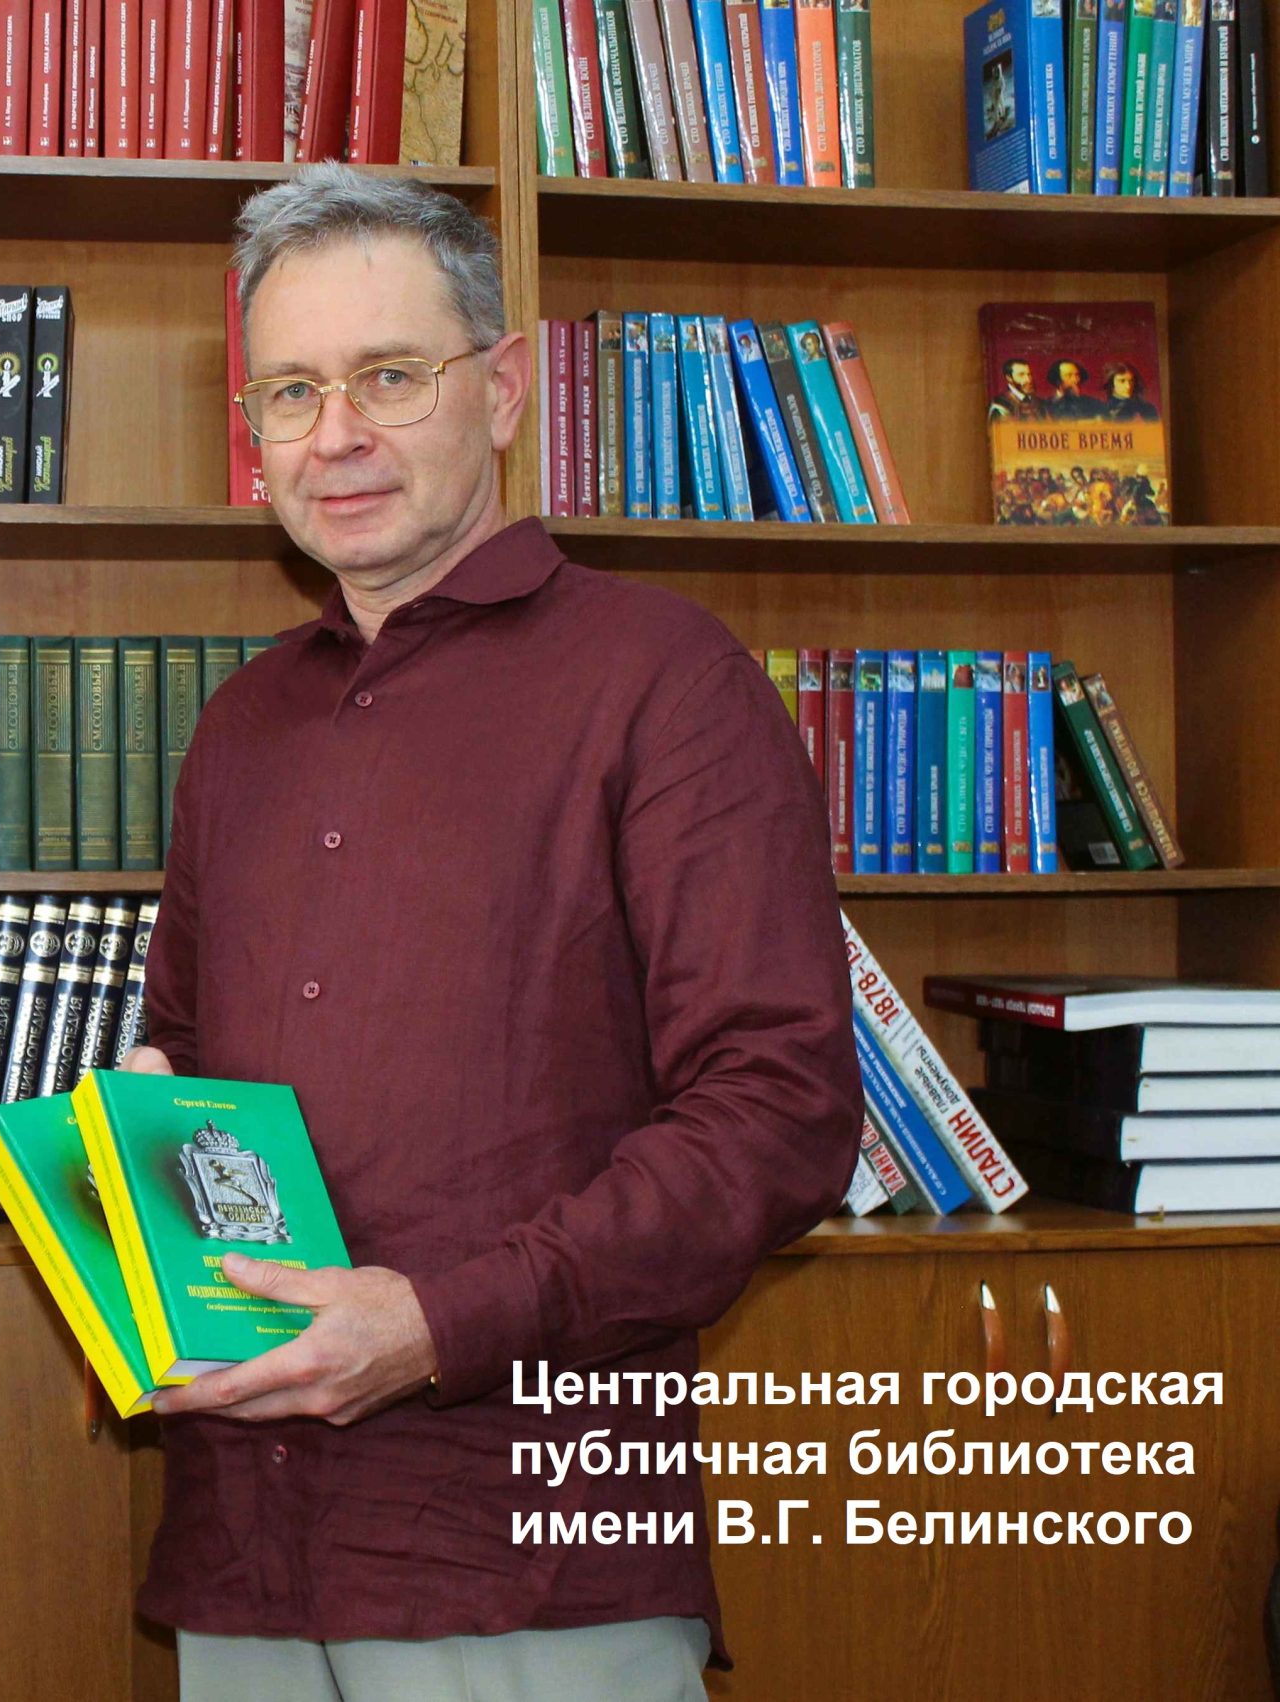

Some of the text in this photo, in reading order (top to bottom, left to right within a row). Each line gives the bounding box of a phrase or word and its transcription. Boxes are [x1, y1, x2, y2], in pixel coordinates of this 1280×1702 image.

[581, 82, 592, 119] ВЕЛИКИХ
[615, 87, 626, 124] ВЕЛИКИХ
[855, 98, 864, 134] ВЕЛИКИХ
[585, 123, 594, 139] СТО
[619, 126, 628, 143] СТО
[856, 136, 864, 154] СТО
[559, 382, 567, 411] науки
[557, 416, 568, 455] русской
[1017, 432, 1134, 450] НОВОЕ ВРЕМЯ
[558, 459, 567, 502] Деятели
[843, 929, 900, 1025] 1878-19
[911, 1065, 950, 1114] главные
[914, 1043, 962, 1105] документы
[174, 1097, 237, 1110] Сергей Глотов
[945, 1107, 1017, 1199] СТАЛИН
